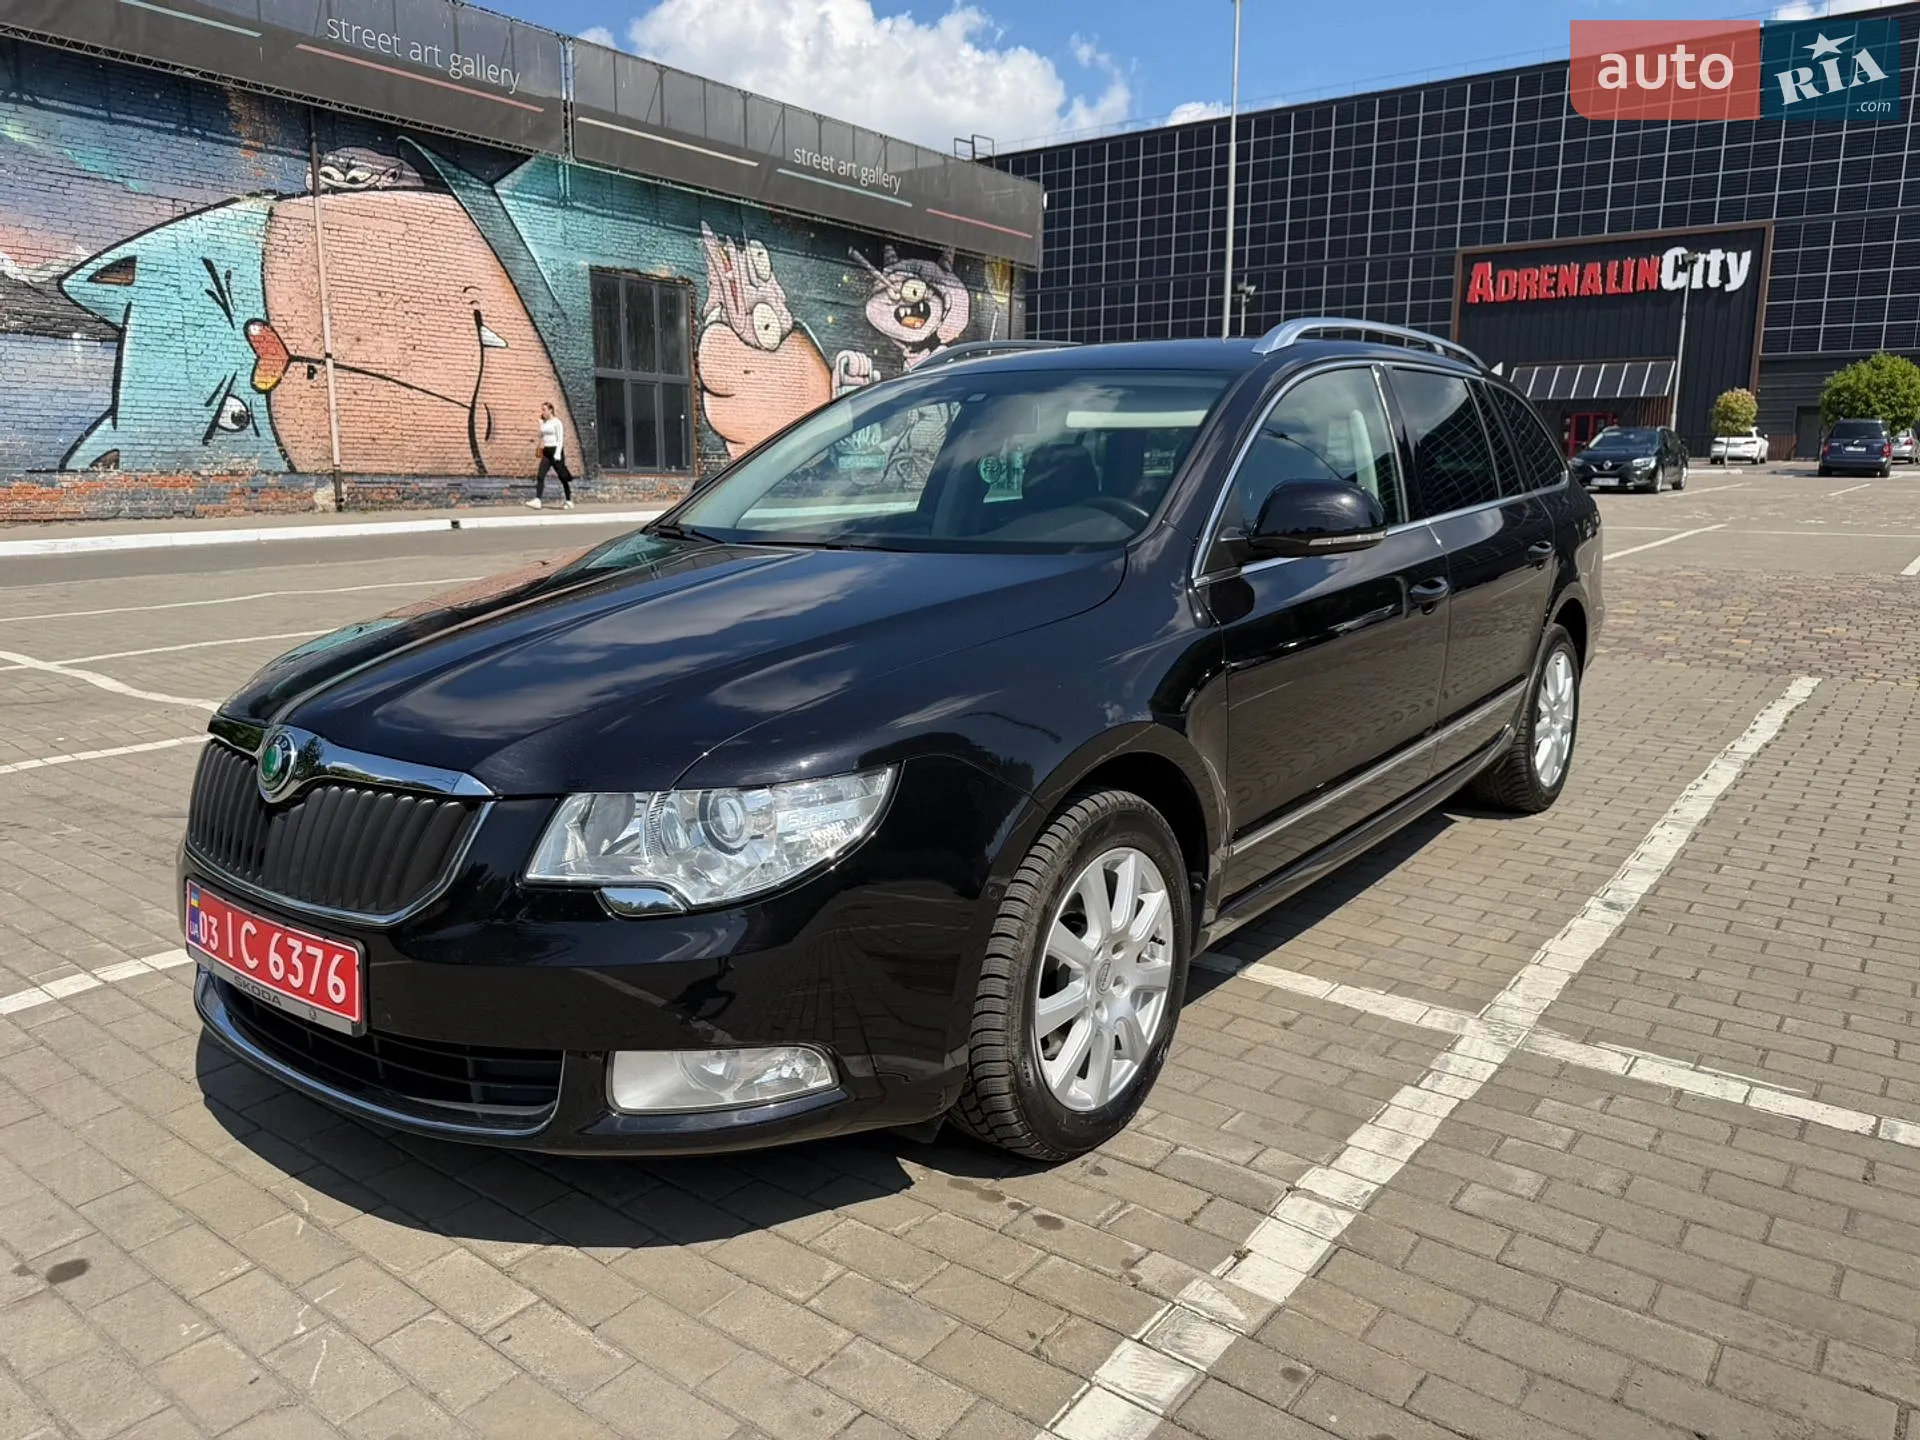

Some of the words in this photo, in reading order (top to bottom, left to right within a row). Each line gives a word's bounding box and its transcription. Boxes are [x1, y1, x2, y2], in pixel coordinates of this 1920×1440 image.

[326, 18, 402, 57] street
[409, 41, 442, 68] art
[449, 53, 520, 95] gallery
[793, 147, 835, 174] street
[837, 160, 857, 179] art
[860, 166, 902, 196] gallery
[200, 911, 219, 950] 03
[268, 932, 346, 1004] 6376
